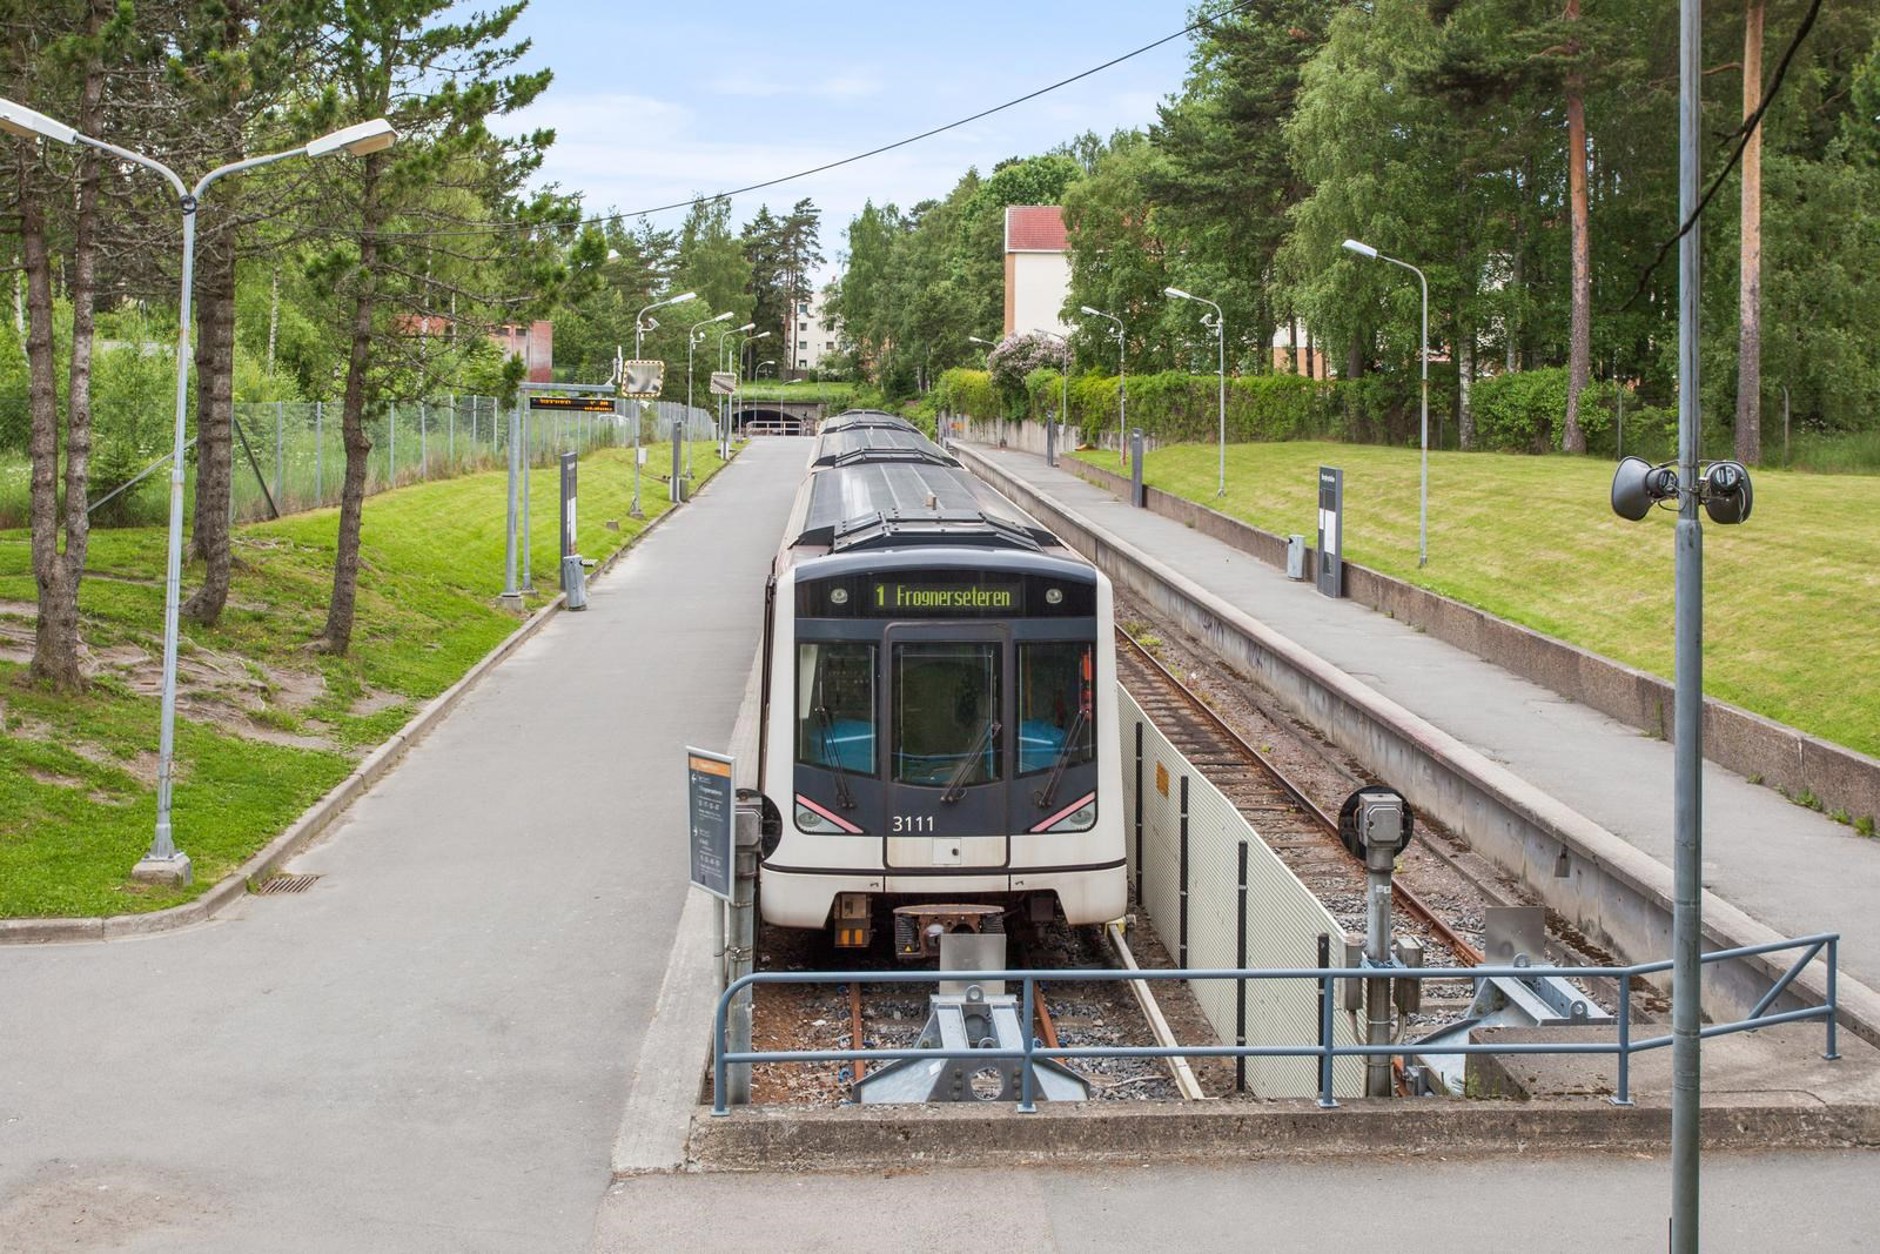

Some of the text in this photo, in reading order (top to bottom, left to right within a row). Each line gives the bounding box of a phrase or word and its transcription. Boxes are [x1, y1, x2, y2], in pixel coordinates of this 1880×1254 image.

[875, 584, 1010, 606] 1 Frognerseteren
[892, 815, 934, 832] 3111
